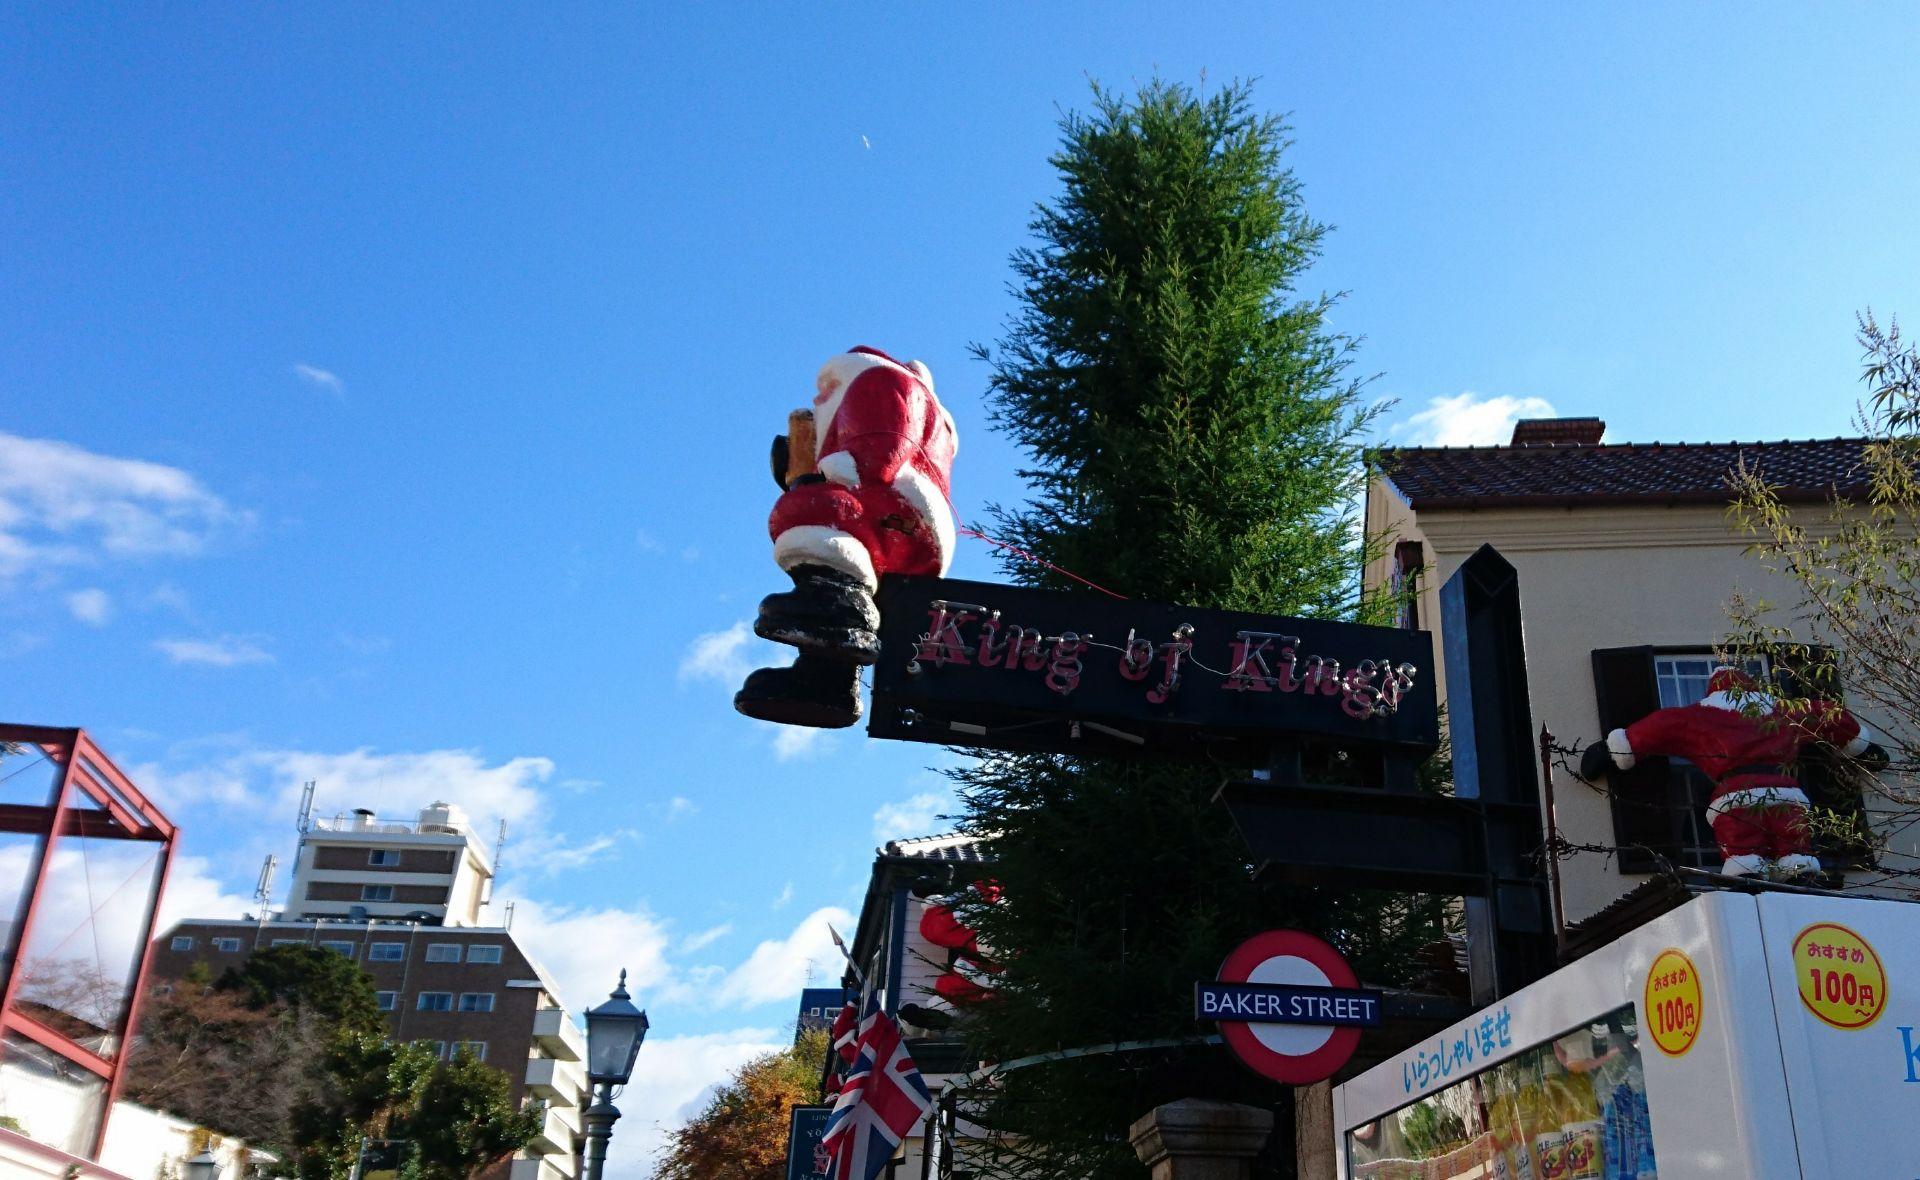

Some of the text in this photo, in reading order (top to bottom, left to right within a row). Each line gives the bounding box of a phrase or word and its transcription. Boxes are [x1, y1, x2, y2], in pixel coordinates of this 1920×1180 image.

[915, 600, 1090, 695] King
[1119, 622, 1195, 704] of
[1808, 942, 1865, 964] おすすめ
[1654, 968, 1688, 992] おすすめ
[1203, 991, 1375, 1020] BAKER STREET
[1403, 1005, 1512, 1094] いらっしゃいませ
